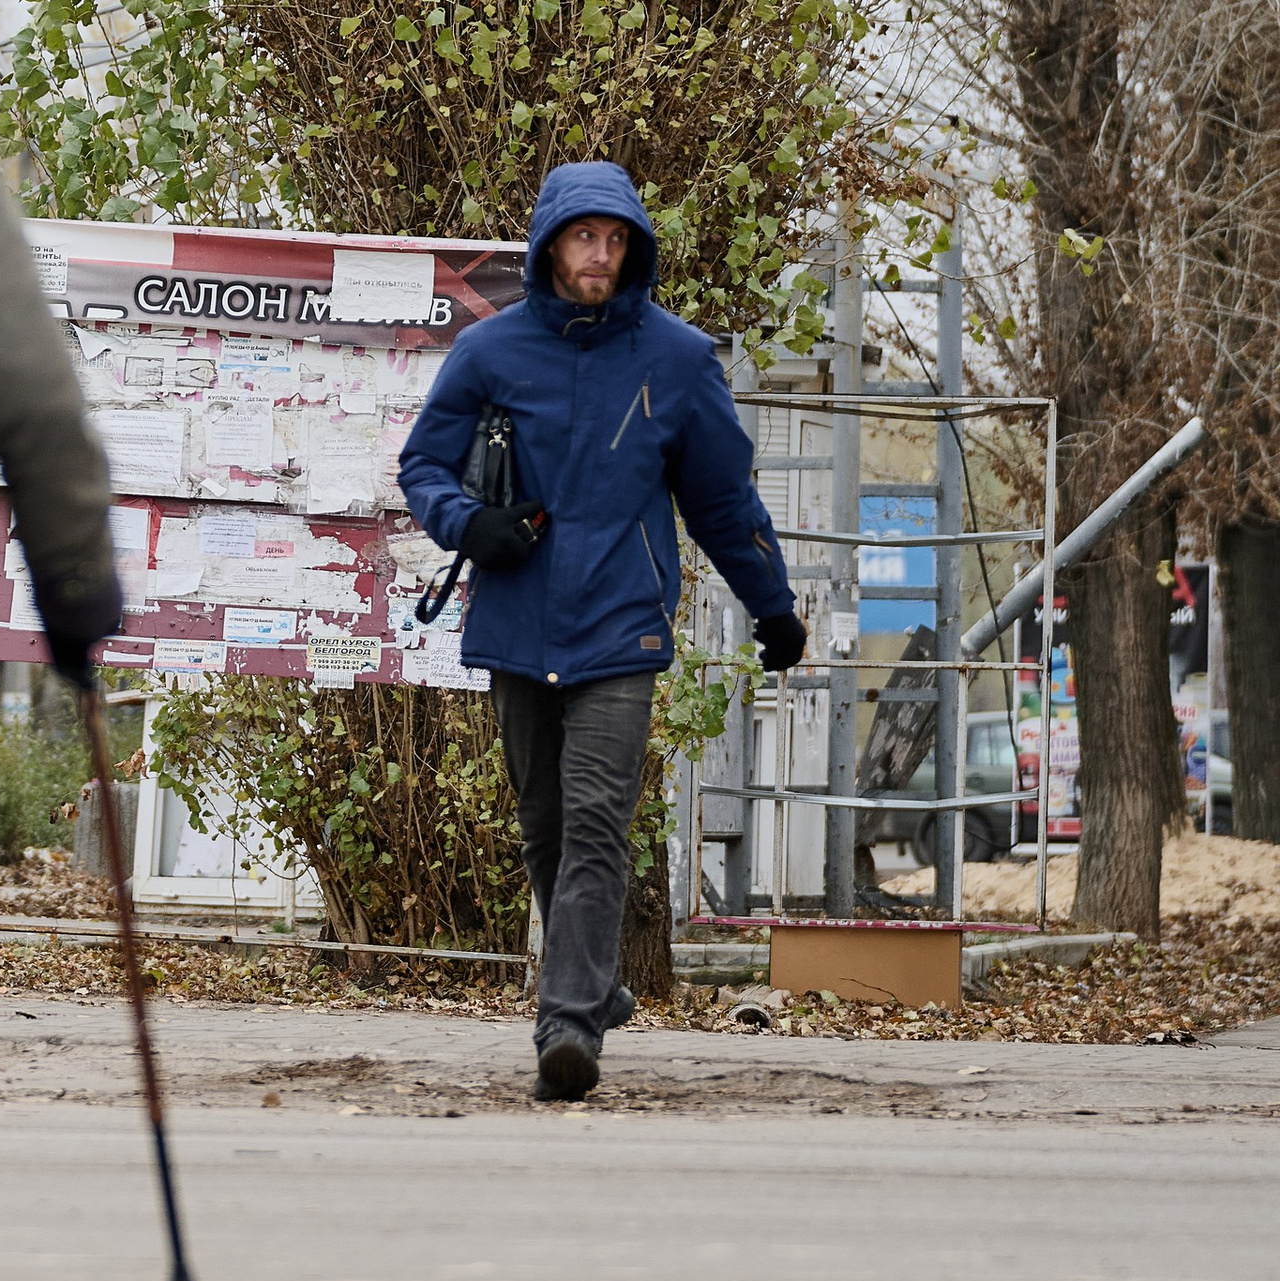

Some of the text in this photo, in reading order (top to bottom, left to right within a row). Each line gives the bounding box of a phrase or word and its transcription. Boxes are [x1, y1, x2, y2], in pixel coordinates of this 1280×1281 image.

[344, 276, 423, 289] Мы открылись
[136, 278, 288, 320] САЛОН
[341, 639, 377, 647] КУРСК
[314, 647, 371, 656] БЕЛГОРОД
